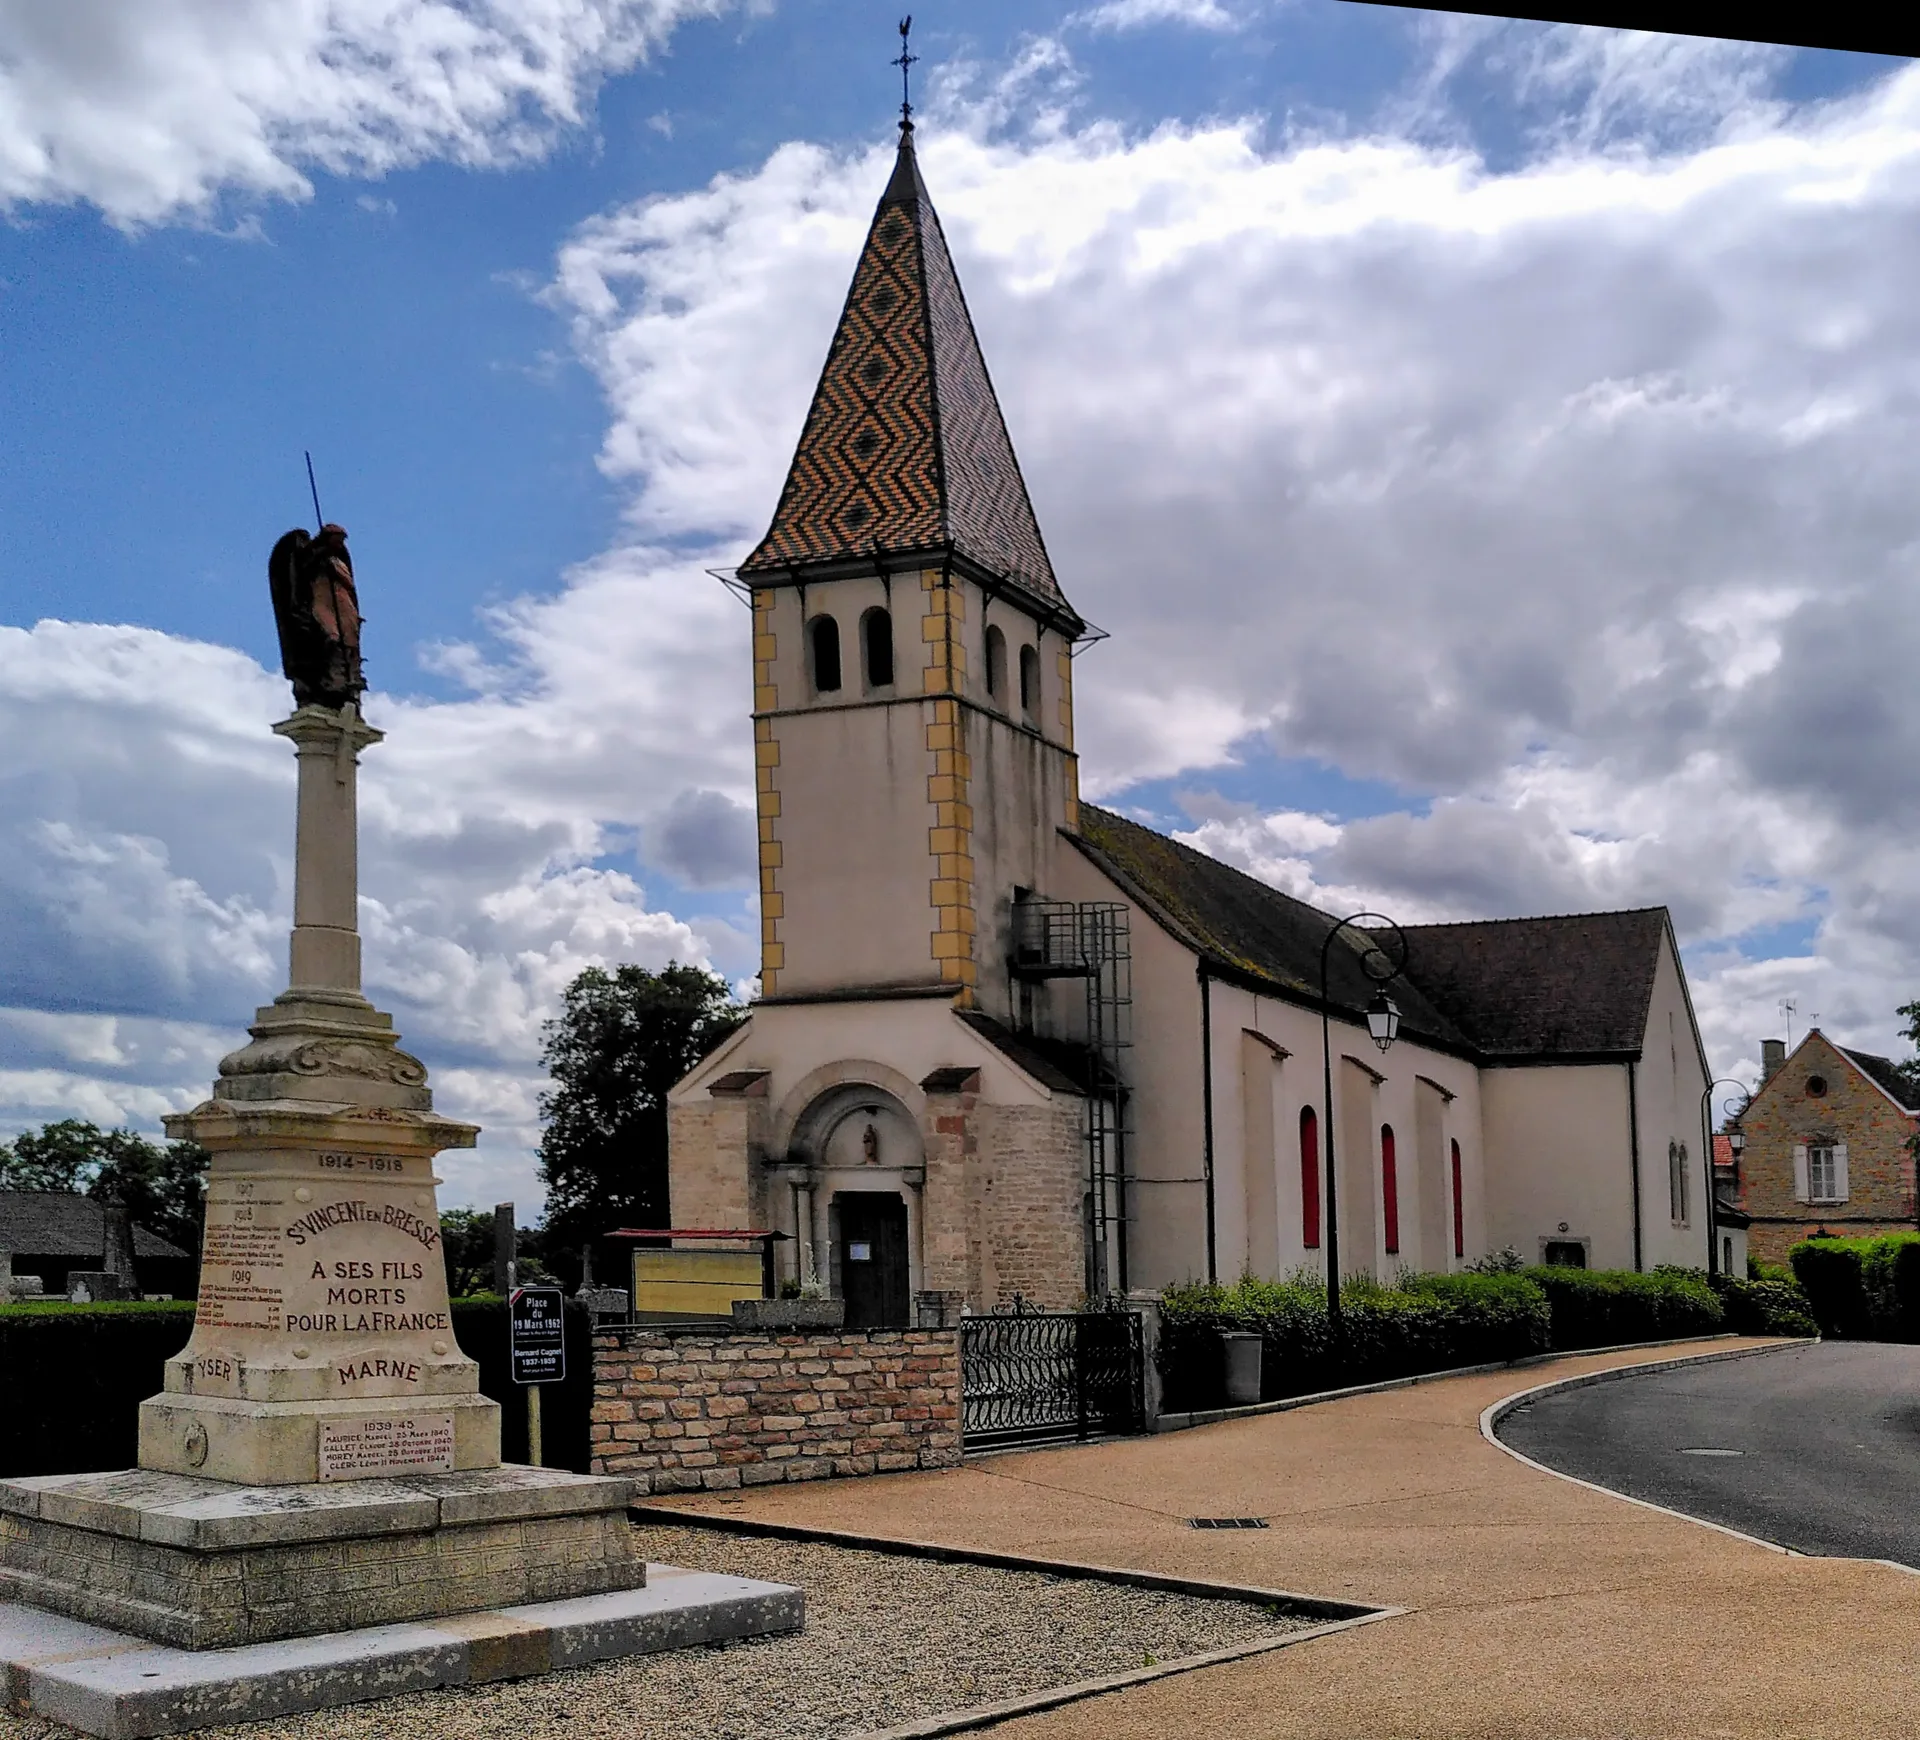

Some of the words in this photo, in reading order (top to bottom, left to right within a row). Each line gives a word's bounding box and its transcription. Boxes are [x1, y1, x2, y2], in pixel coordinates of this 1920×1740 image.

[318, 1154, 403, 1172] 1914-1918
[305, 1200, 366, 1236] VINCENT
[367, 1208, 382, 1222] EN
[384, 1204, 441, 1251] BRESSE
[231, 1270, 251, 1284] 1919
[311, 1261, 326, 1279] A
[335, 1261, 374, 1279] SES
[382, 1262, 423, 1280] FILS
[327, 1288, 406, 1305] MORTS
[526, 1297, 548, 1308] Place
[532, 1309, 543, 1319] du
[286, 1314, 337, 1332] POUR
[343, 1314, 369, 1331] LA
[371, 1312, 448, 1332] FRANCE
[514, 1320, 523, 1330] 19
[524, 1319, 543, 1330] Mars
[544, 1318, 560, 1329] 1962
[514, 1349, 539, 1357] Bernard
[198, 1359, 231, 1381] YSER
[337, 1360, 421, 1386] MARNE
[364, 1420, 415, 1432] 1939-45
[323, 1443, 355, 1453] GALLET
